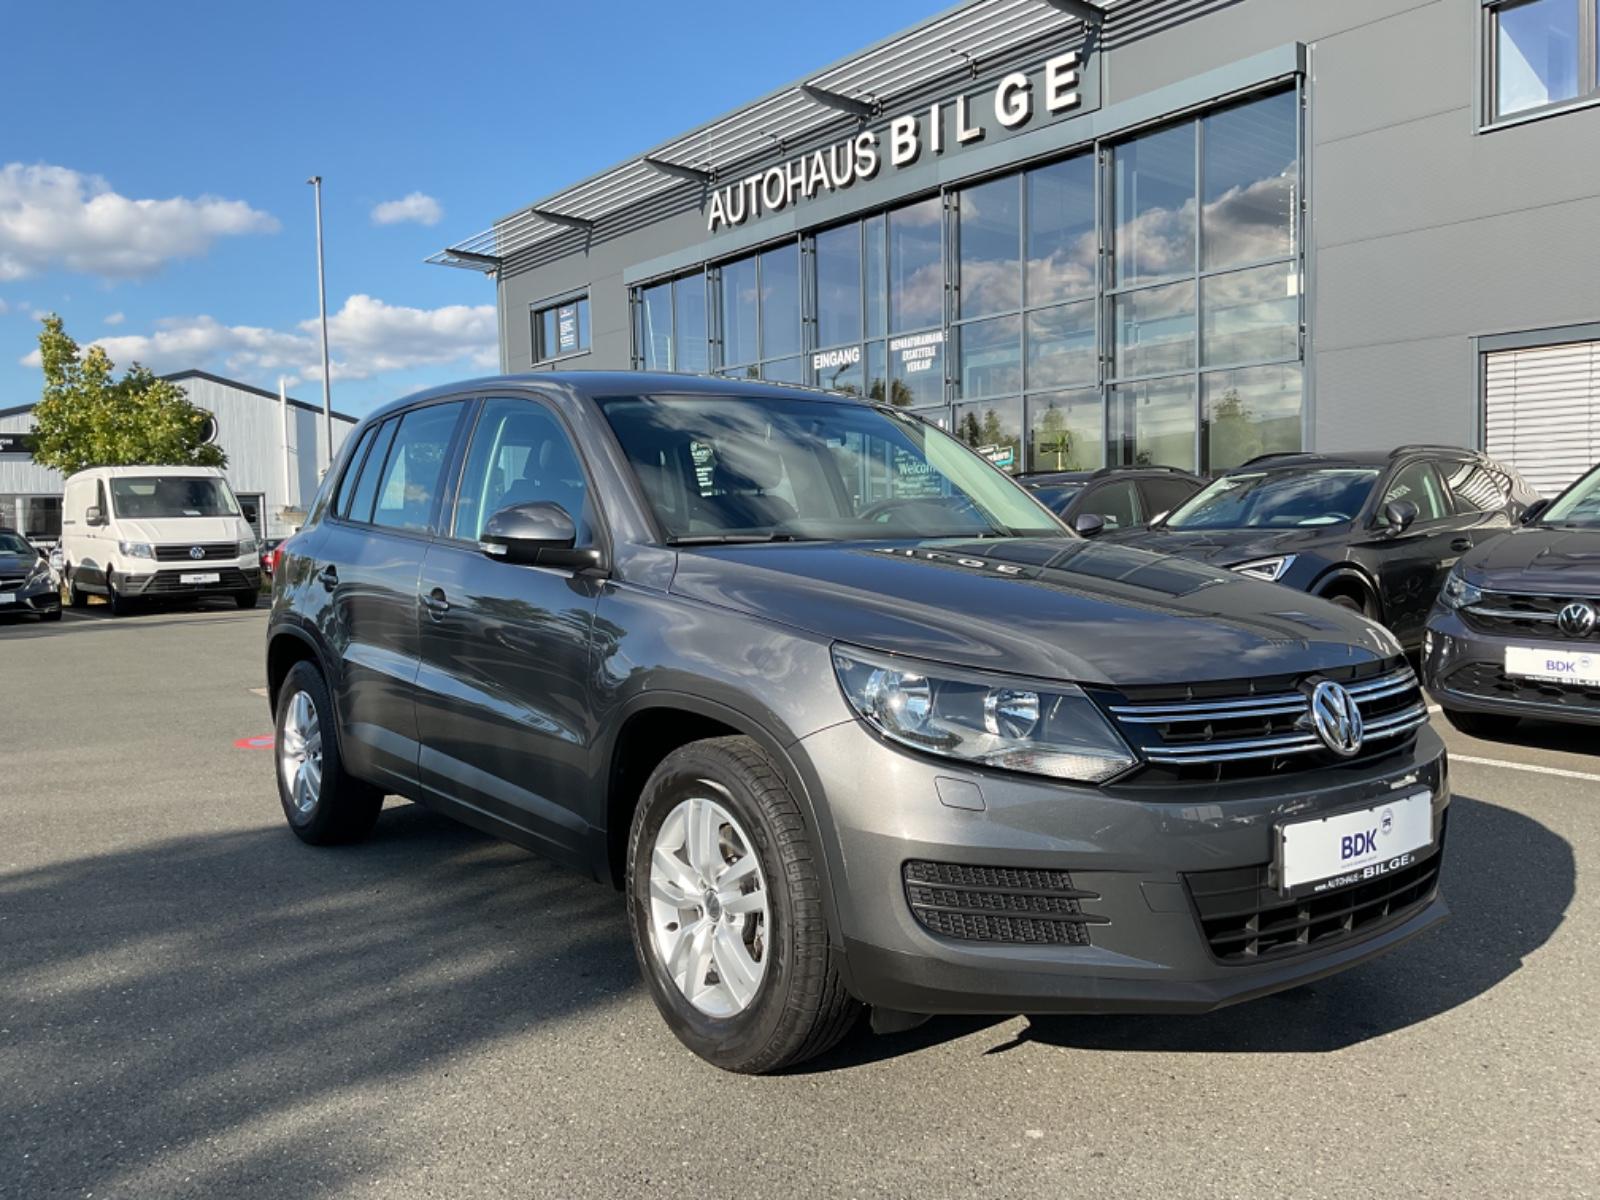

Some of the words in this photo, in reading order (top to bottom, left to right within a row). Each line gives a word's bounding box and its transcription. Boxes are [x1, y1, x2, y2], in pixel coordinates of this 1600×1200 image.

[708, 131, 879, 231] AUTOHAUS
[891, 51, 1081, 167] BILGE
[814, 347, 860, 369] EINGANG
[898, 463, 936, 475] Welcom
[1546, 659, 1576, 673] BDK
[1340, 828, 1378, 860] BDK
